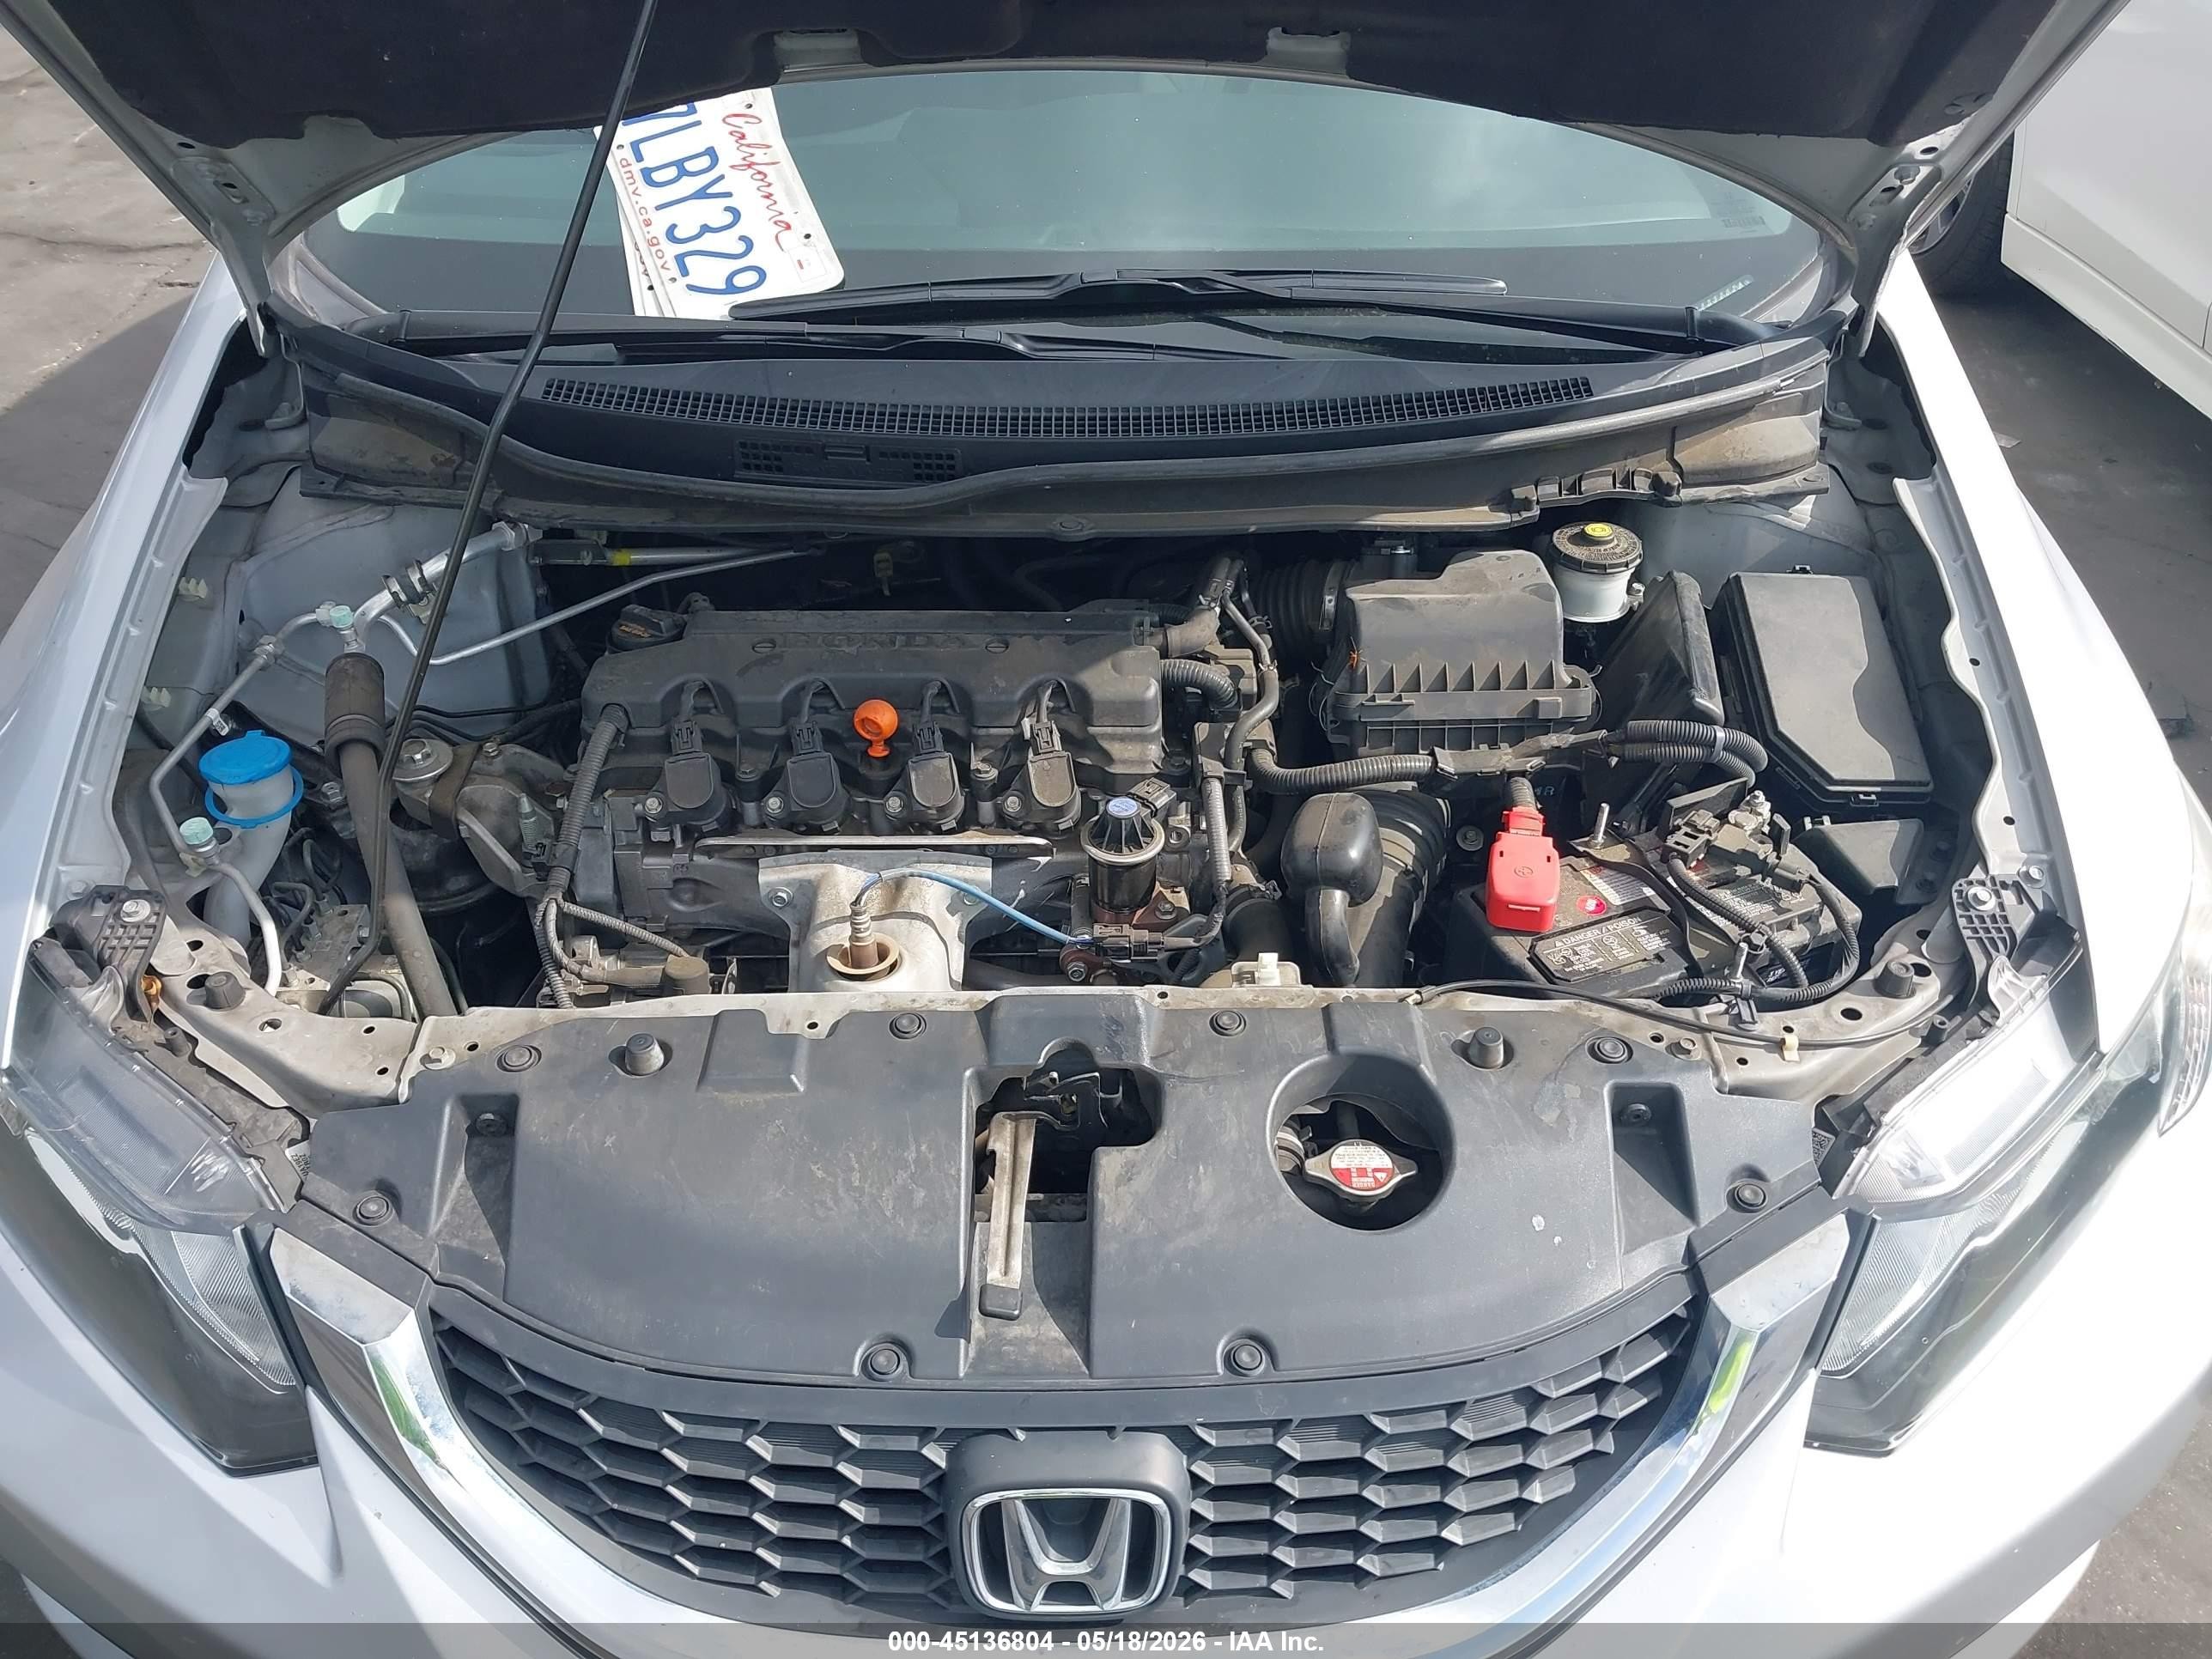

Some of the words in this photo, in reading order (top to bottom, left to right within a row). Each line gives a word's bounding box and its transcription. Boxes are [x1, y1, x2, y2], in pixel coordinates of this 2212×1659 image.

[618, 157, 672, 272] dmv.ca.gov
[721, 113, 805, 252] California
[1563, 930, 1602, 945] DANGER
[1607, 917, 1642, 932] POISON
